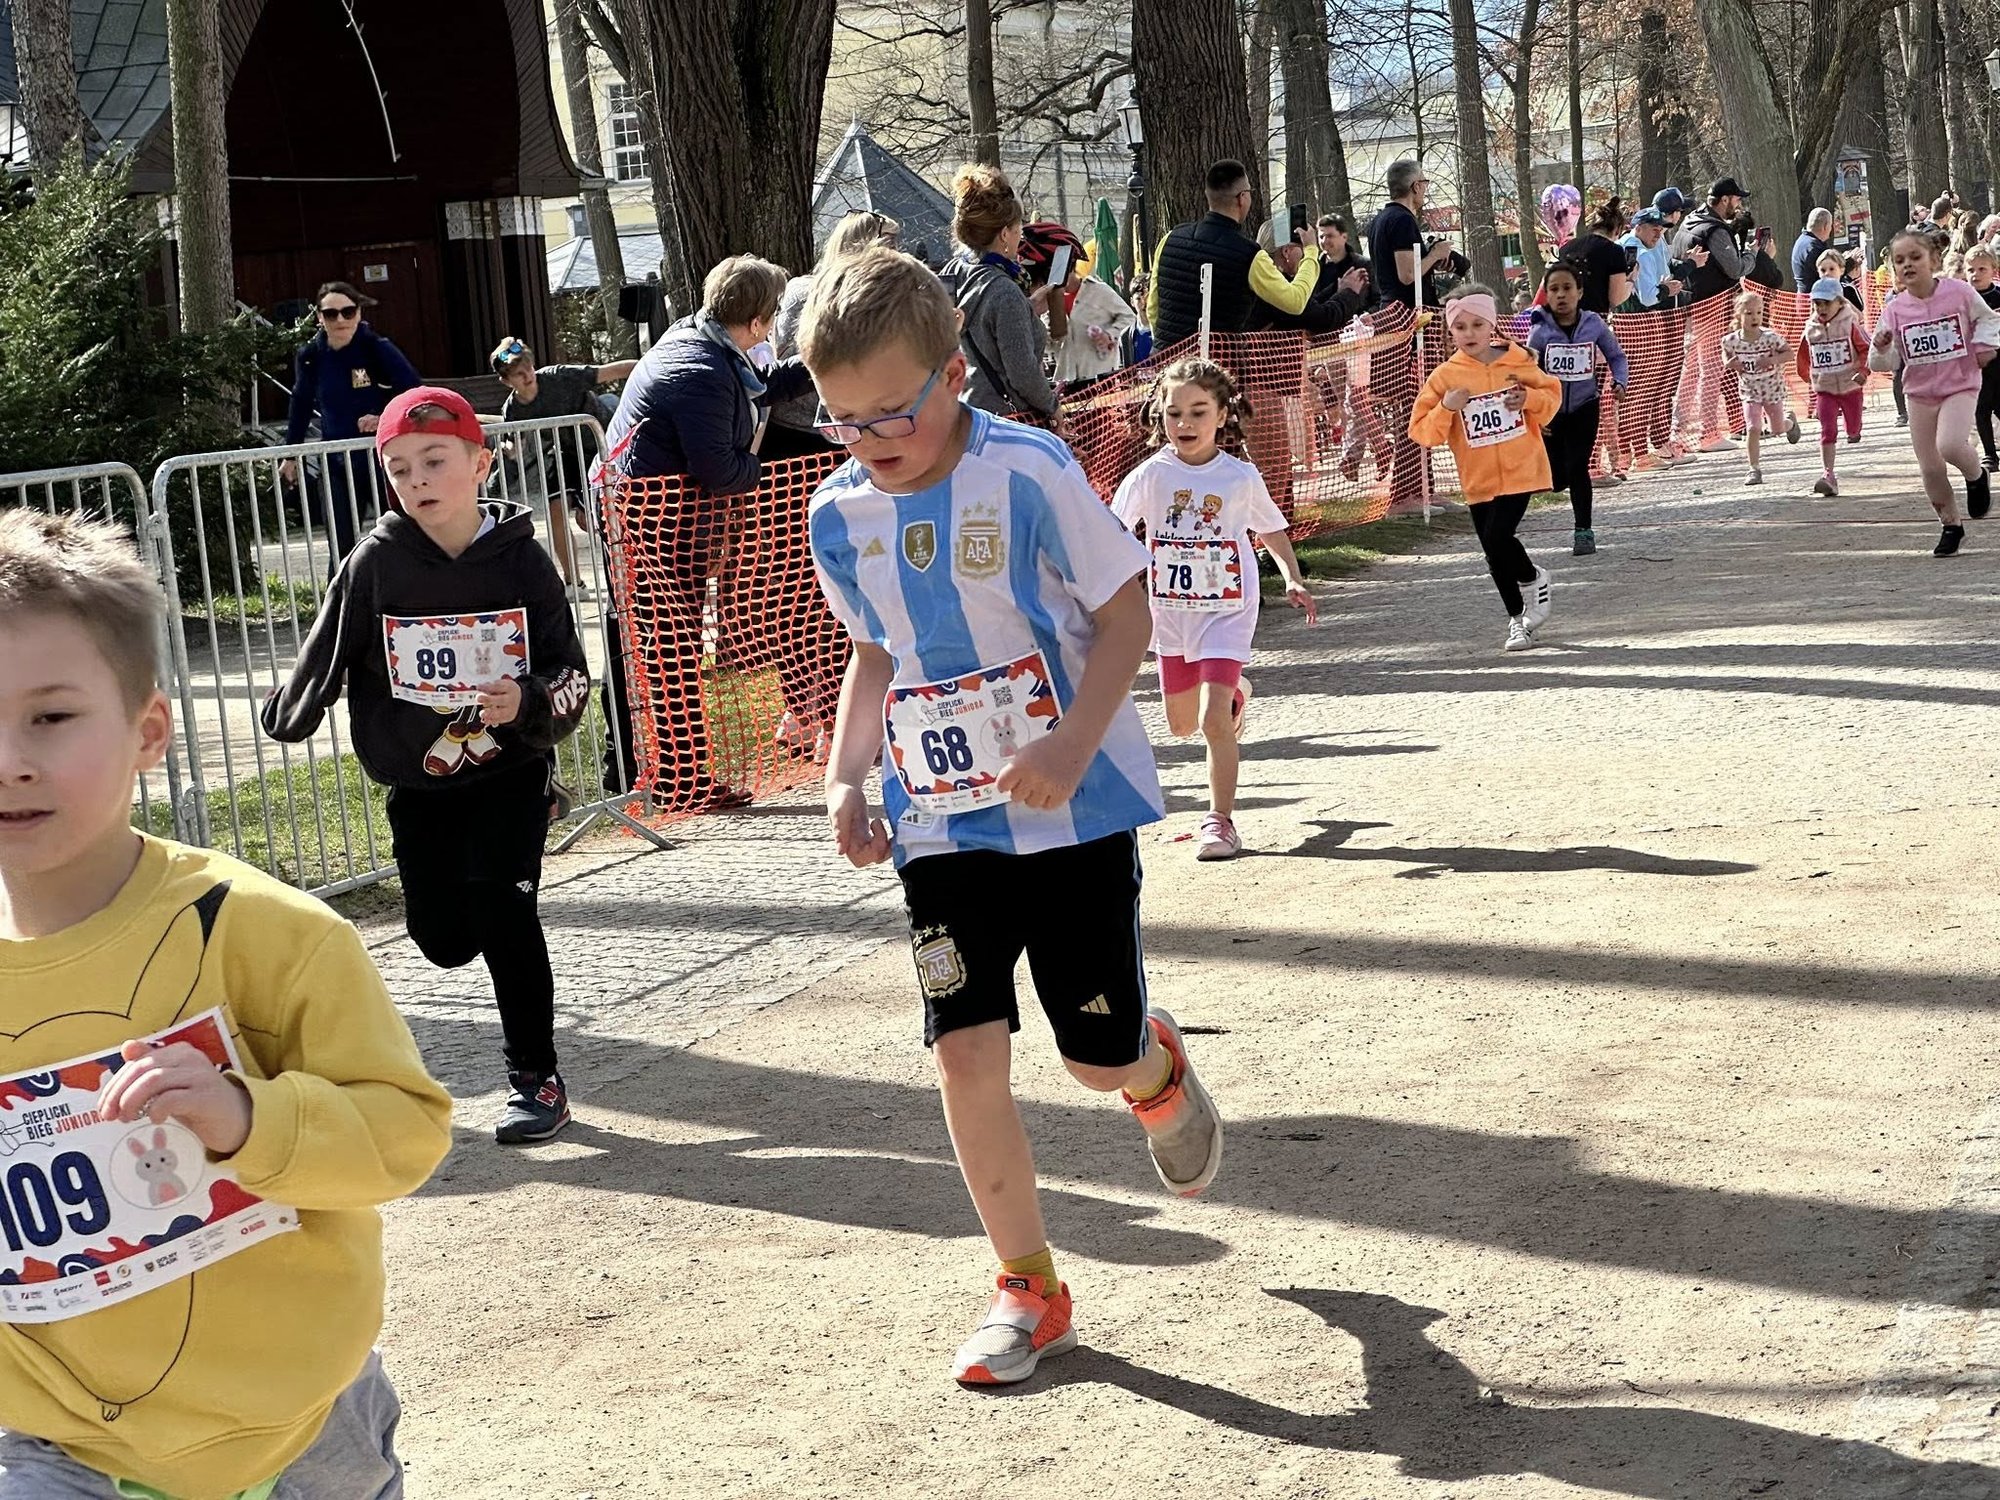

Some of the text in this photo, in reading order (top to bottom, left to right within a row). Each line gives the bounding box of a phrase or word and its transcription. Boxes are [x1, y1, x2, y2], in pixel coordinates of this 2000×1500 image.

[1912, 334, 1939, 352] 250
[1552, 356, 1575, 370] 248
[1815, 351, 1832, 364] 126
[1471, 409, 1502, 432] 246
[965, 536, 993, 564] AFA
[1167, 564, 1193, 590] 78
[415, 647, 457, 680] 89
[939, 700, 984, 718] BIEG JUNIORA
[921, 725, 974, 776] 68
[22, 1102, 71, 1126] CIEPLICKI
[26, 1110, 105, 1140] BIEG JUNIOR
[0, 1151, 111, 1251] 109
